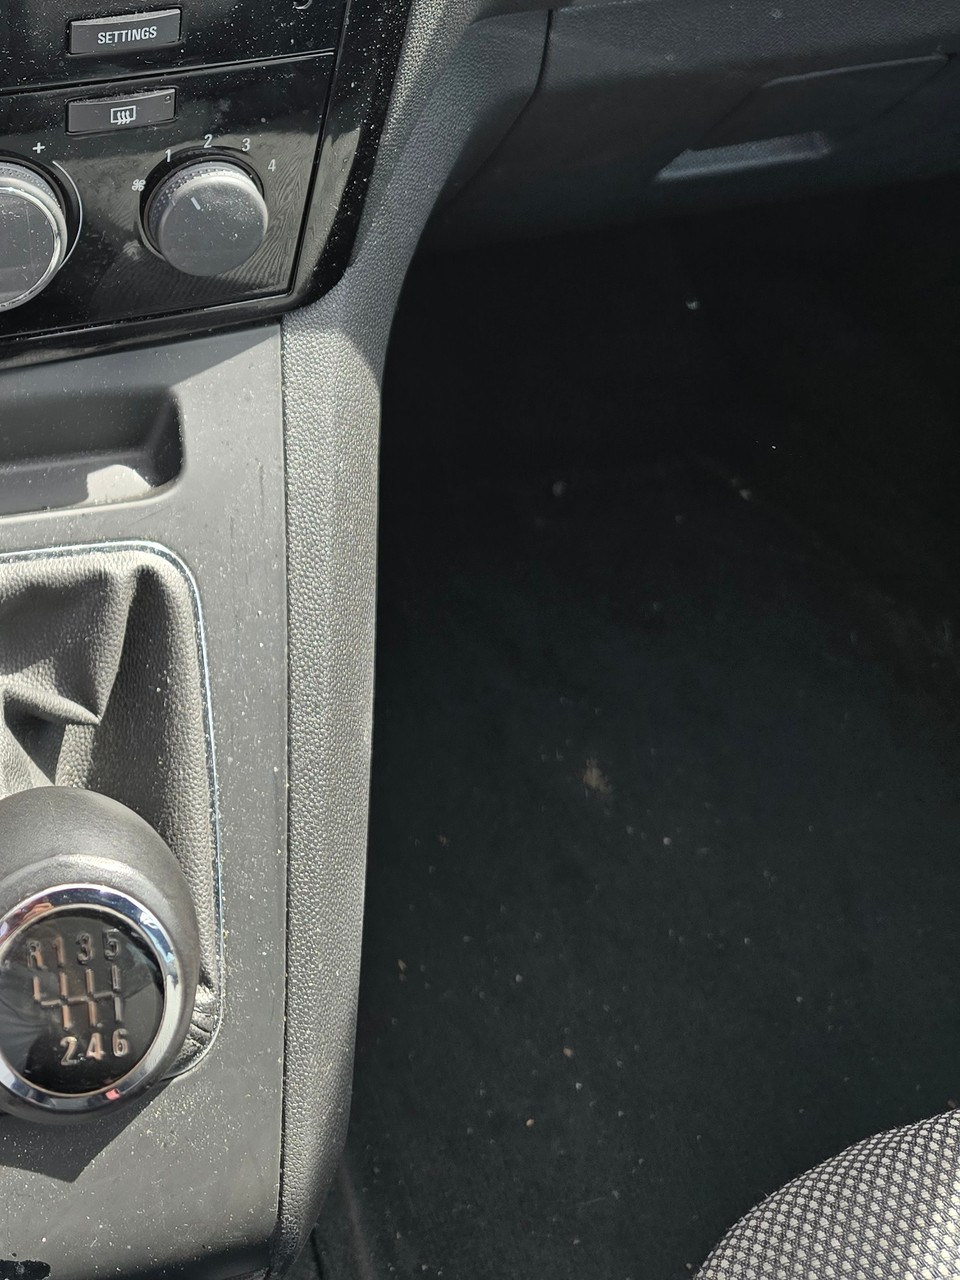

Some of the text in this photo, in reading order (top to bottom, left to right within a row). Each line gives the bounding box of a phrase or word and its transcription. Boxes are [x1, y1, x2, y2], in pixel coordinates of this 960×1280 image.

[97, 26, 157, 44] SETTINGS
[203, 134, 213, 150] 2
[241, 138, 250, 152] 3
[164, 149, 172, 163] 1
[268, 159, 276, 172] 4
[54, 935, 65, 966] 1
[77, 932, 94, 964] 3
[103, 927, 120, 960] 5
[60, 1028, 129, 1066] 2 4 6
